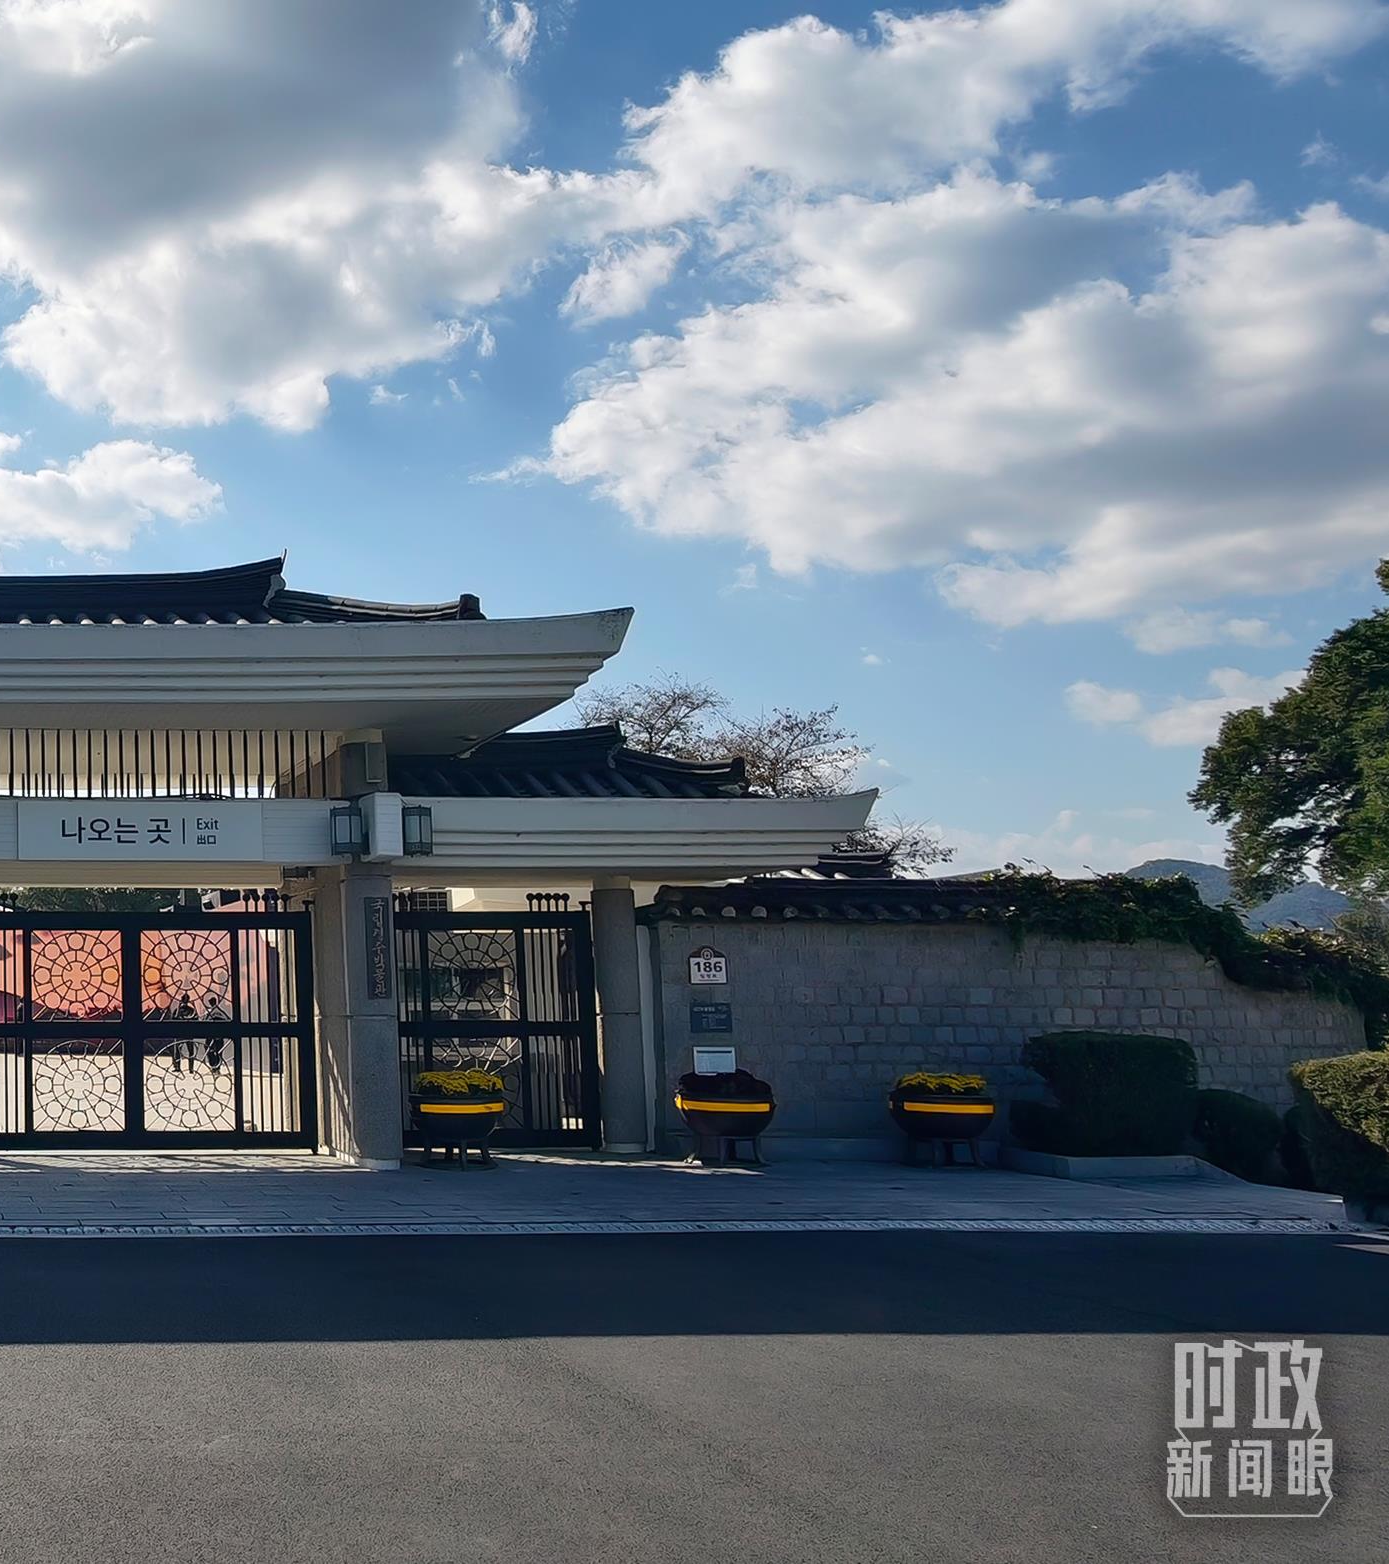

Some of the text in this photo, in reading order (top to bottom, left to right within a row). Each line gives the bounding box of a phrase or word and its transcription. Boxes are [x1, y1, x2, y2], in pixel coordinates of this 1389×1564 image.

[61, 816, 172, 845] 나오는 곳
[196, 818, 219, 831] Exit
[196, 834, 217, 845] 出口
[693, 961, 723, 973] 186
